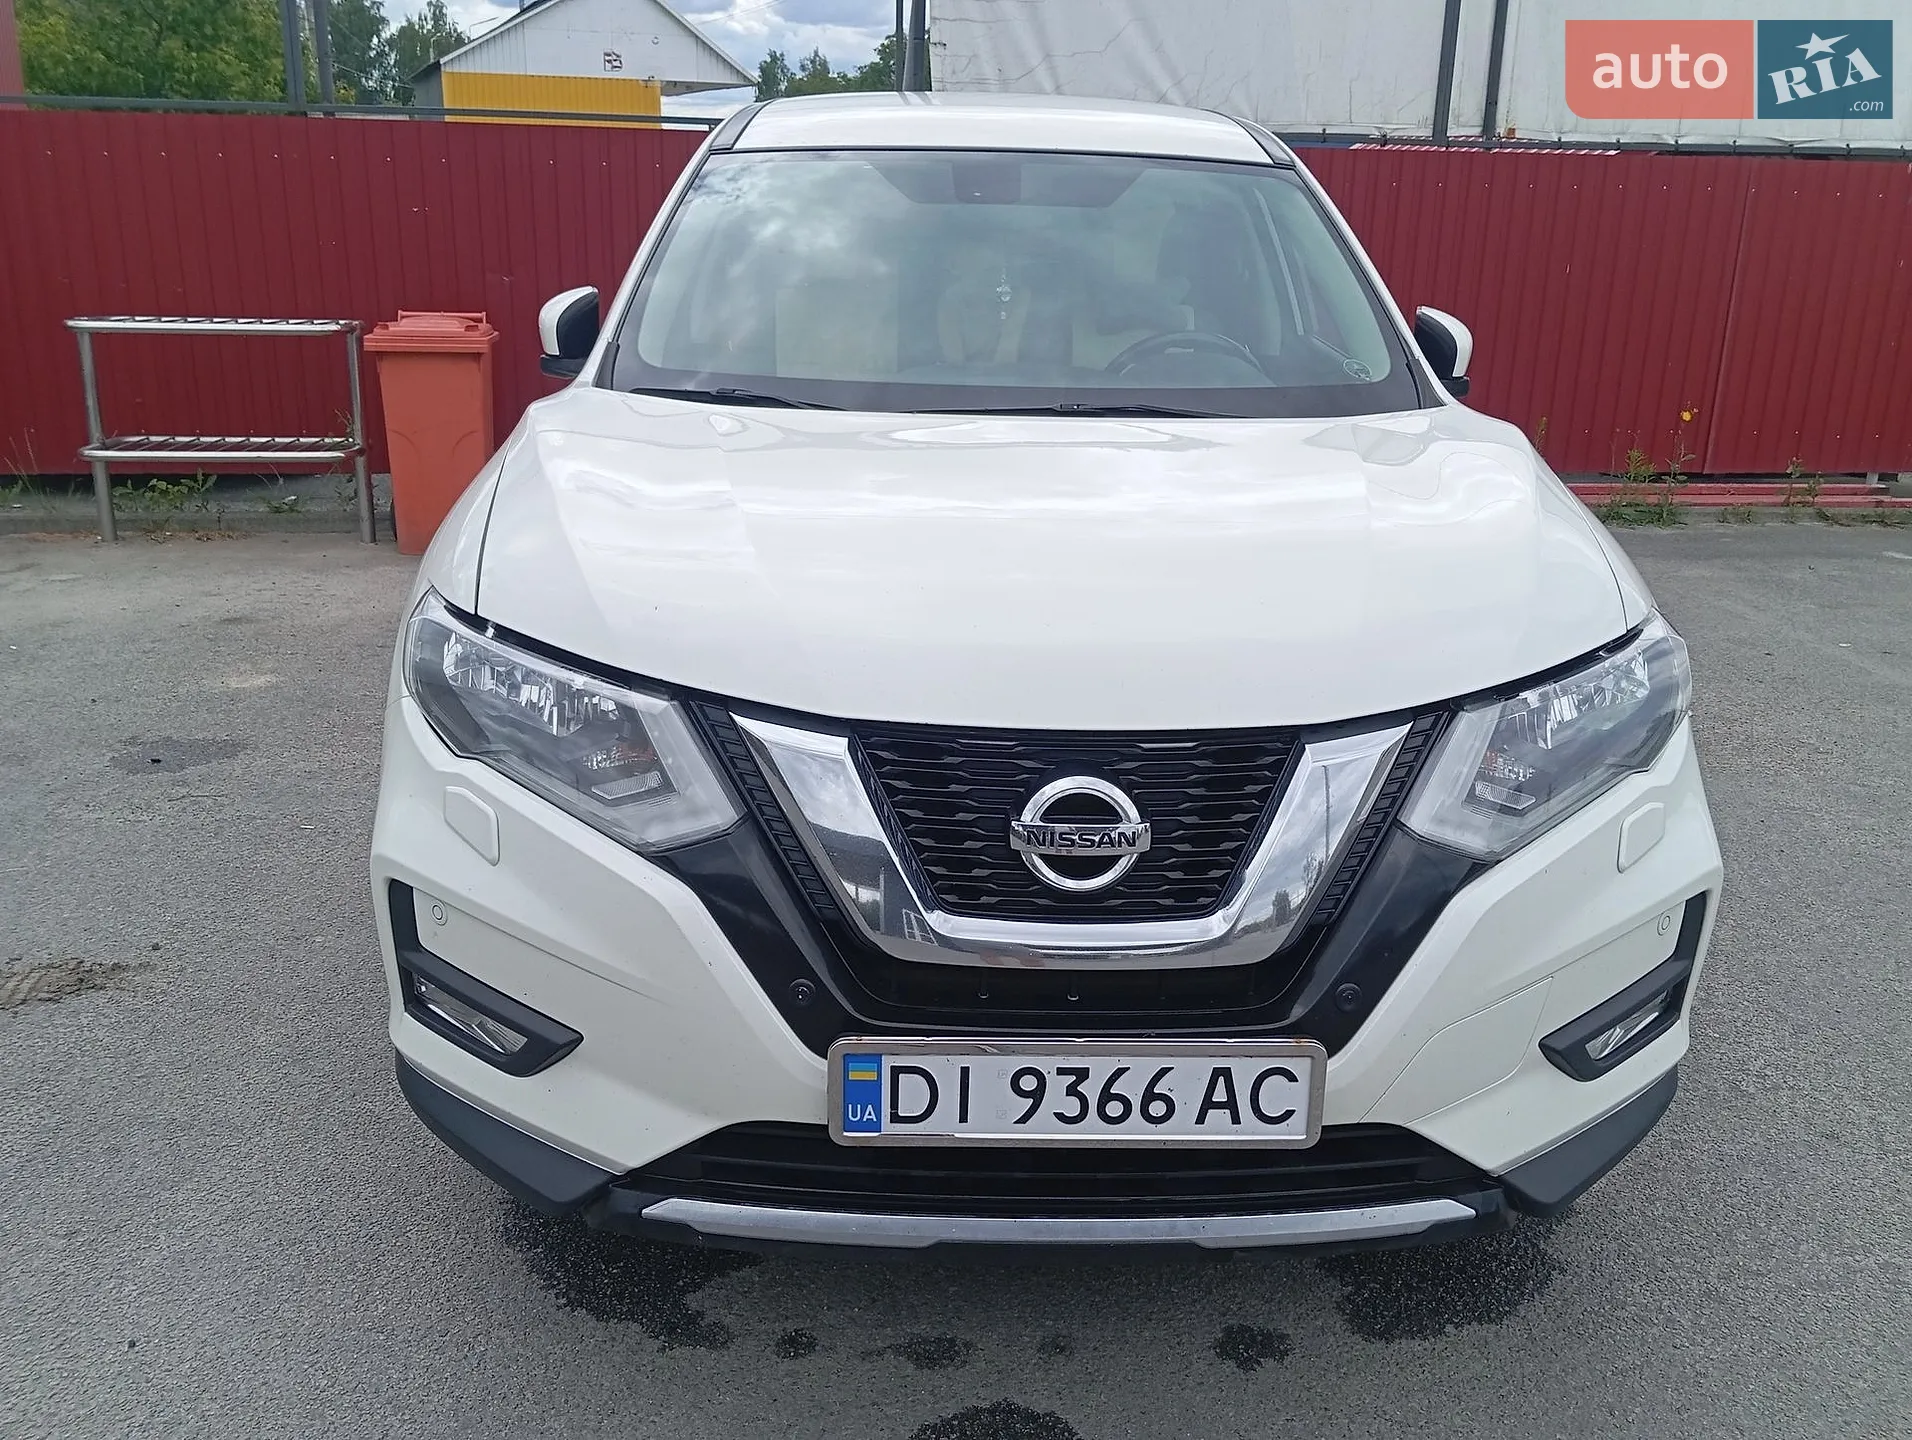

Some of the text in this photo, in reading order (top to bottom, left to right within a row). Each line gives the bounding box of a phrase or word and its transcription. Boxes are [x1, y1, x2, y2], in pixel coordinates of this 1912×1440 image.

[1026, 830, 1137, 848] NISSAN
[889, 1066, 1300, 1126] DI 9366 AC
[848, 1104, 877, 1123] UA
